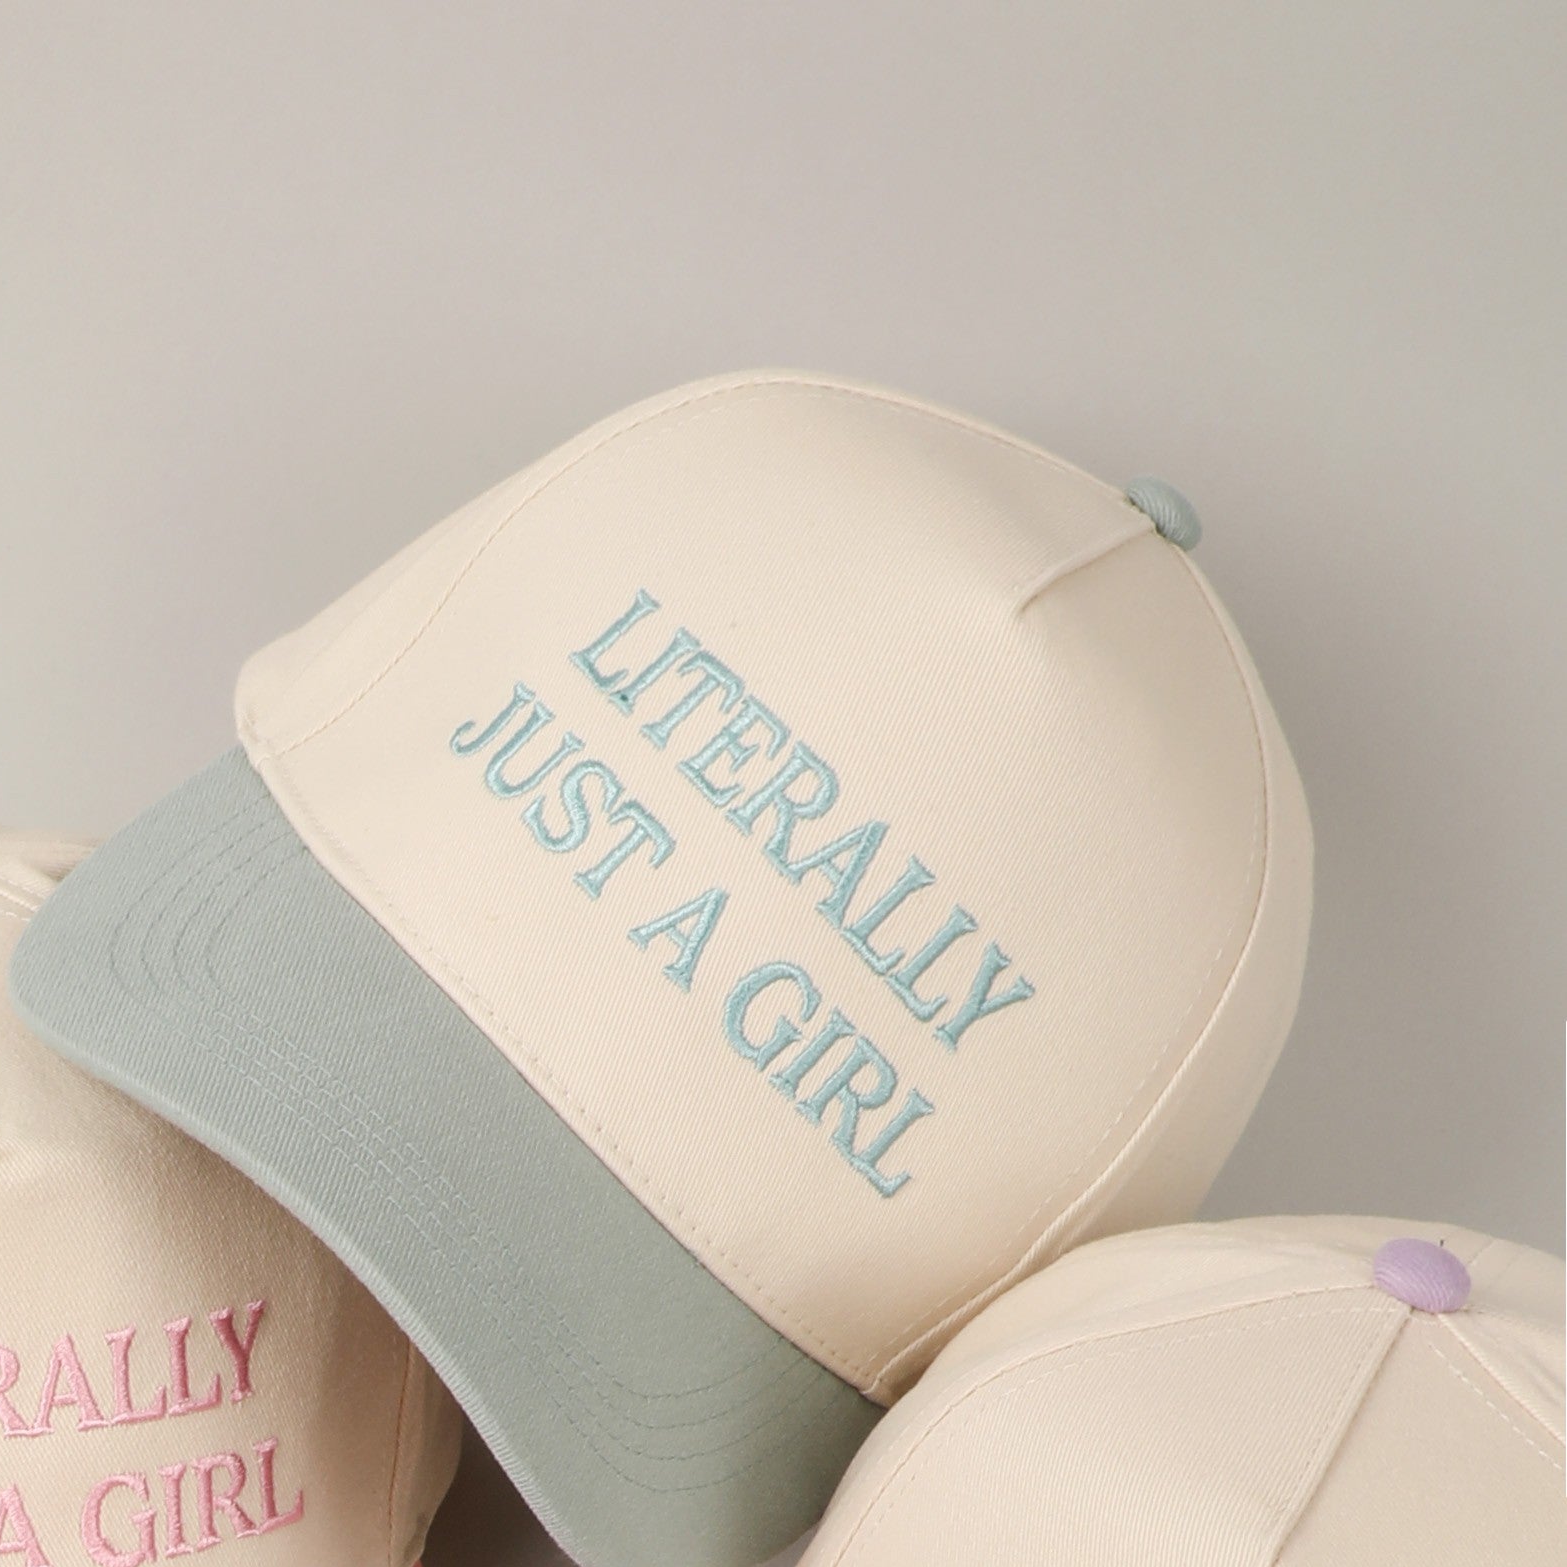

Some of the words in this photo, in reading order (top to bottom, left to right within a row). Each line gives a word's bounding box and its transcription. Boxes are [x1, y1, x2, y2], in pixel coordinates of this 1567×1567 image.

[449, 680, 676, 900] JUST
[627, 886, 731, 993] A
[720, 960, 936, 1200] GIRL
[569, 587, 1035, 1052] LITERALLY
